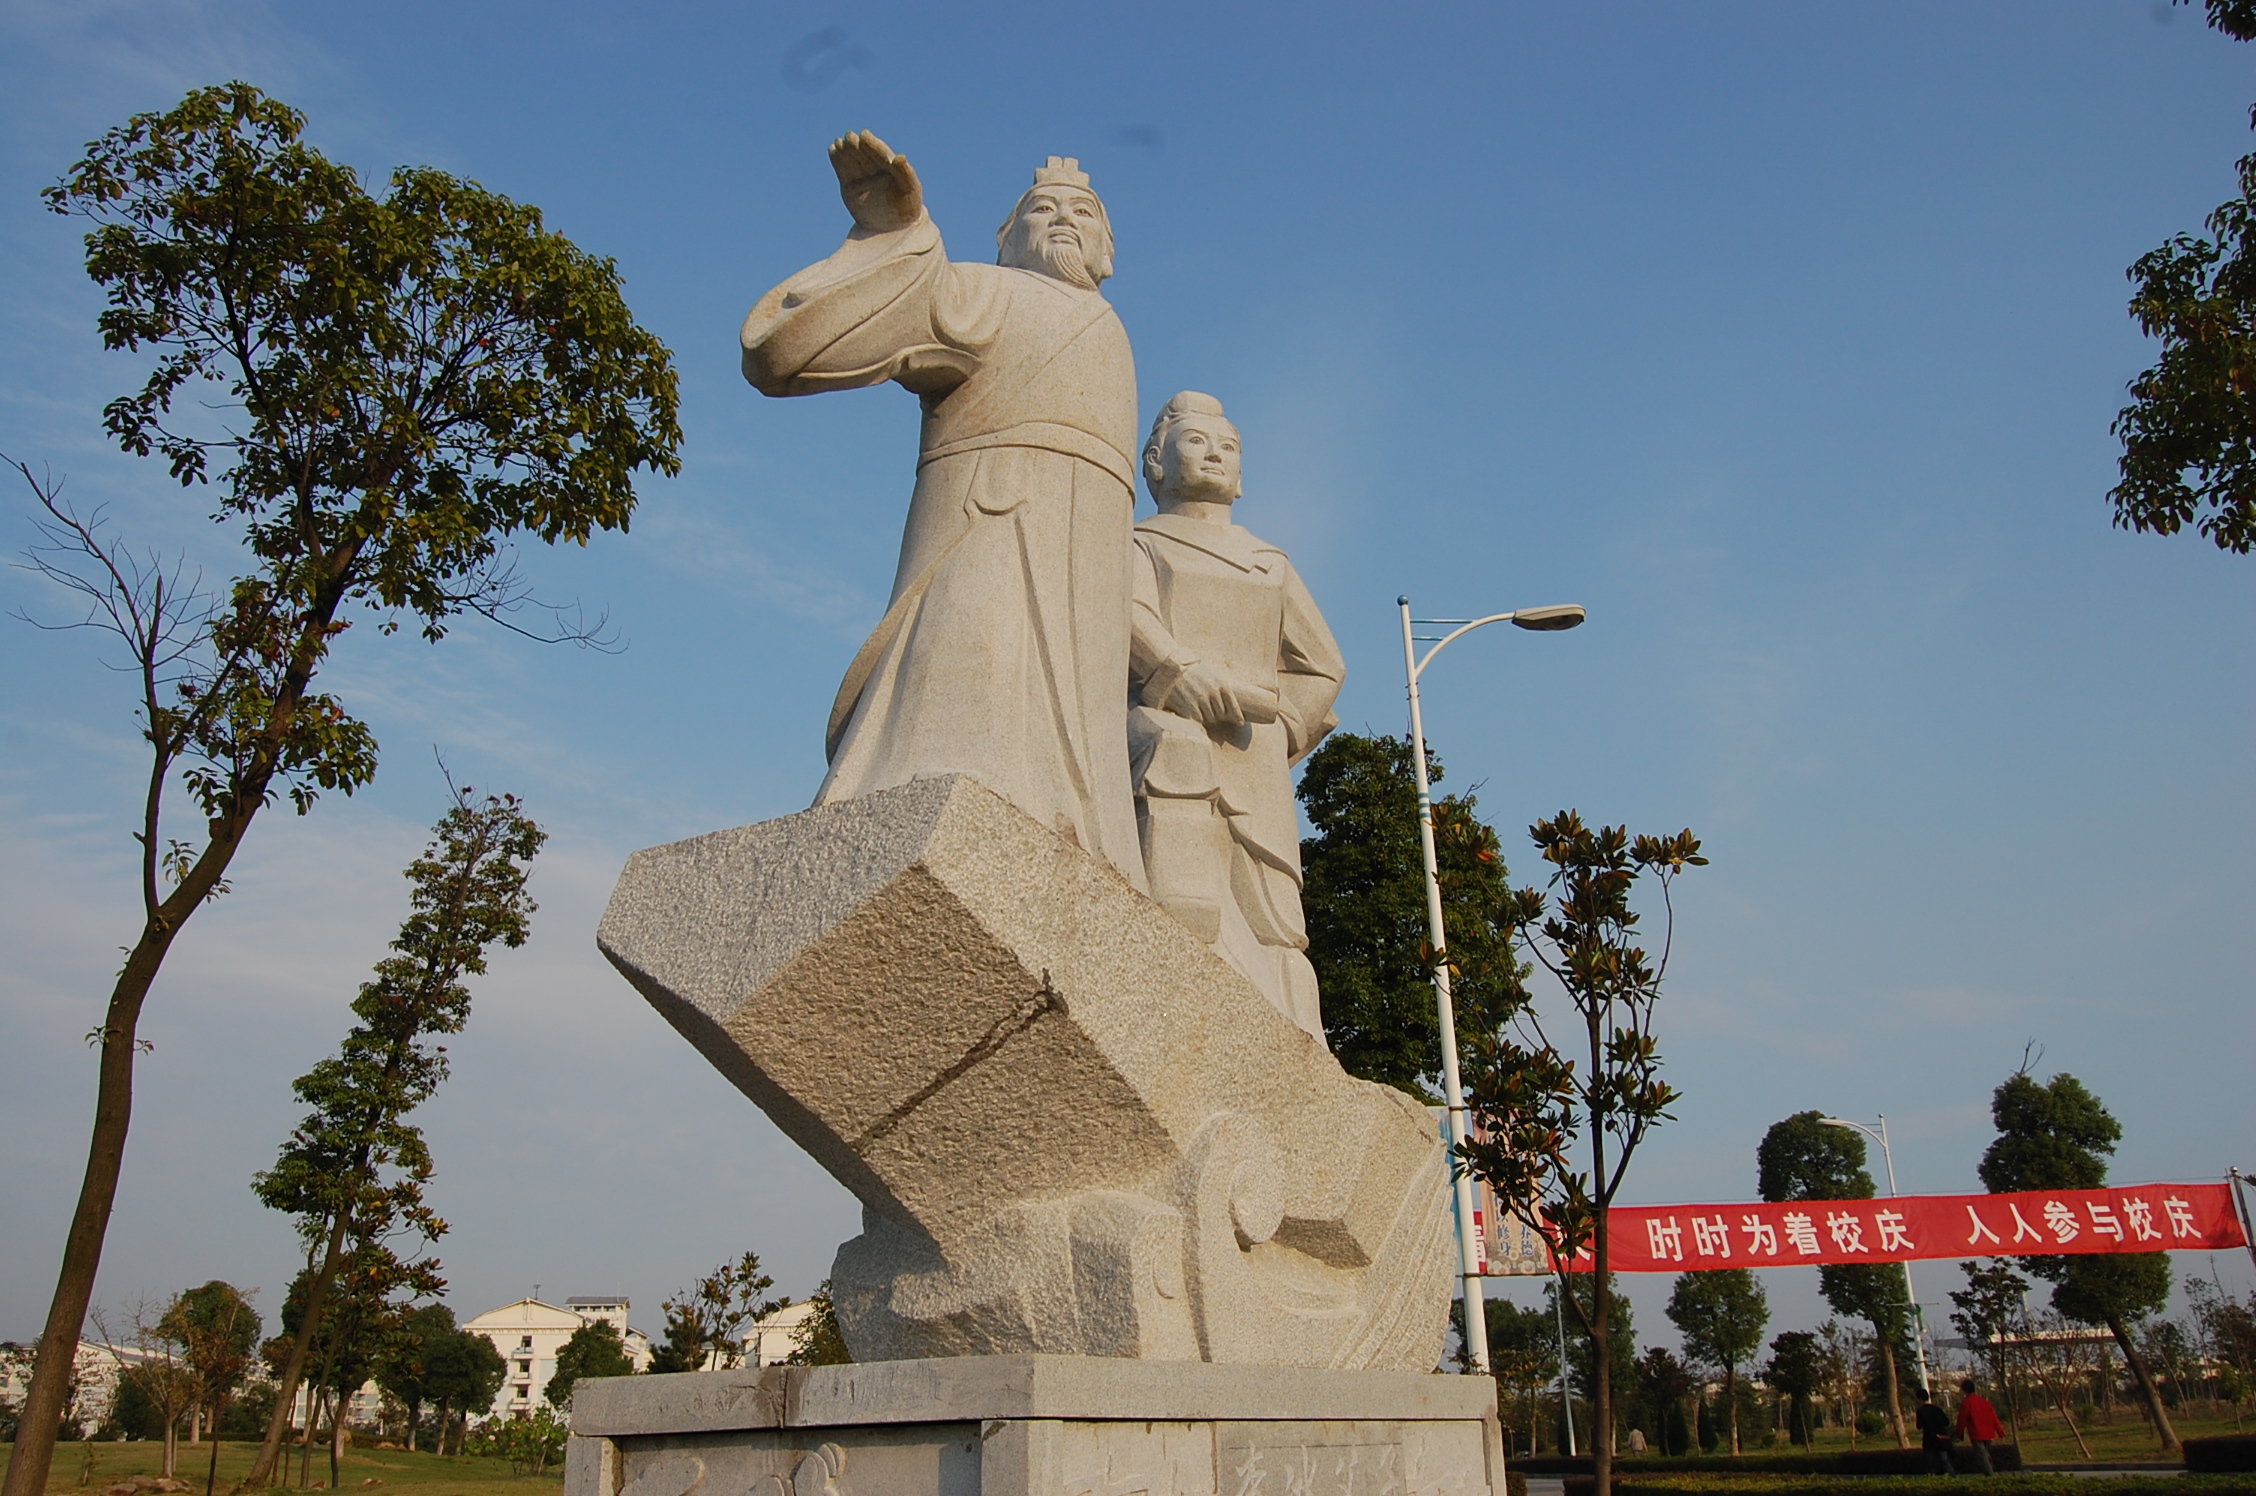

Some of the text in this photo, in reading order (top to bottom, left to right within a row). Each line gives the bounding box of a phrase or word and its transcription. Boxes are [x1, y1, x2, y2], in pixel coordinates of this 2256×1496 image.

[1645, 1208, 1915, 1262] 时时为着校庆
[1965, 1195, 2202, 1245] 人人参与校庆
